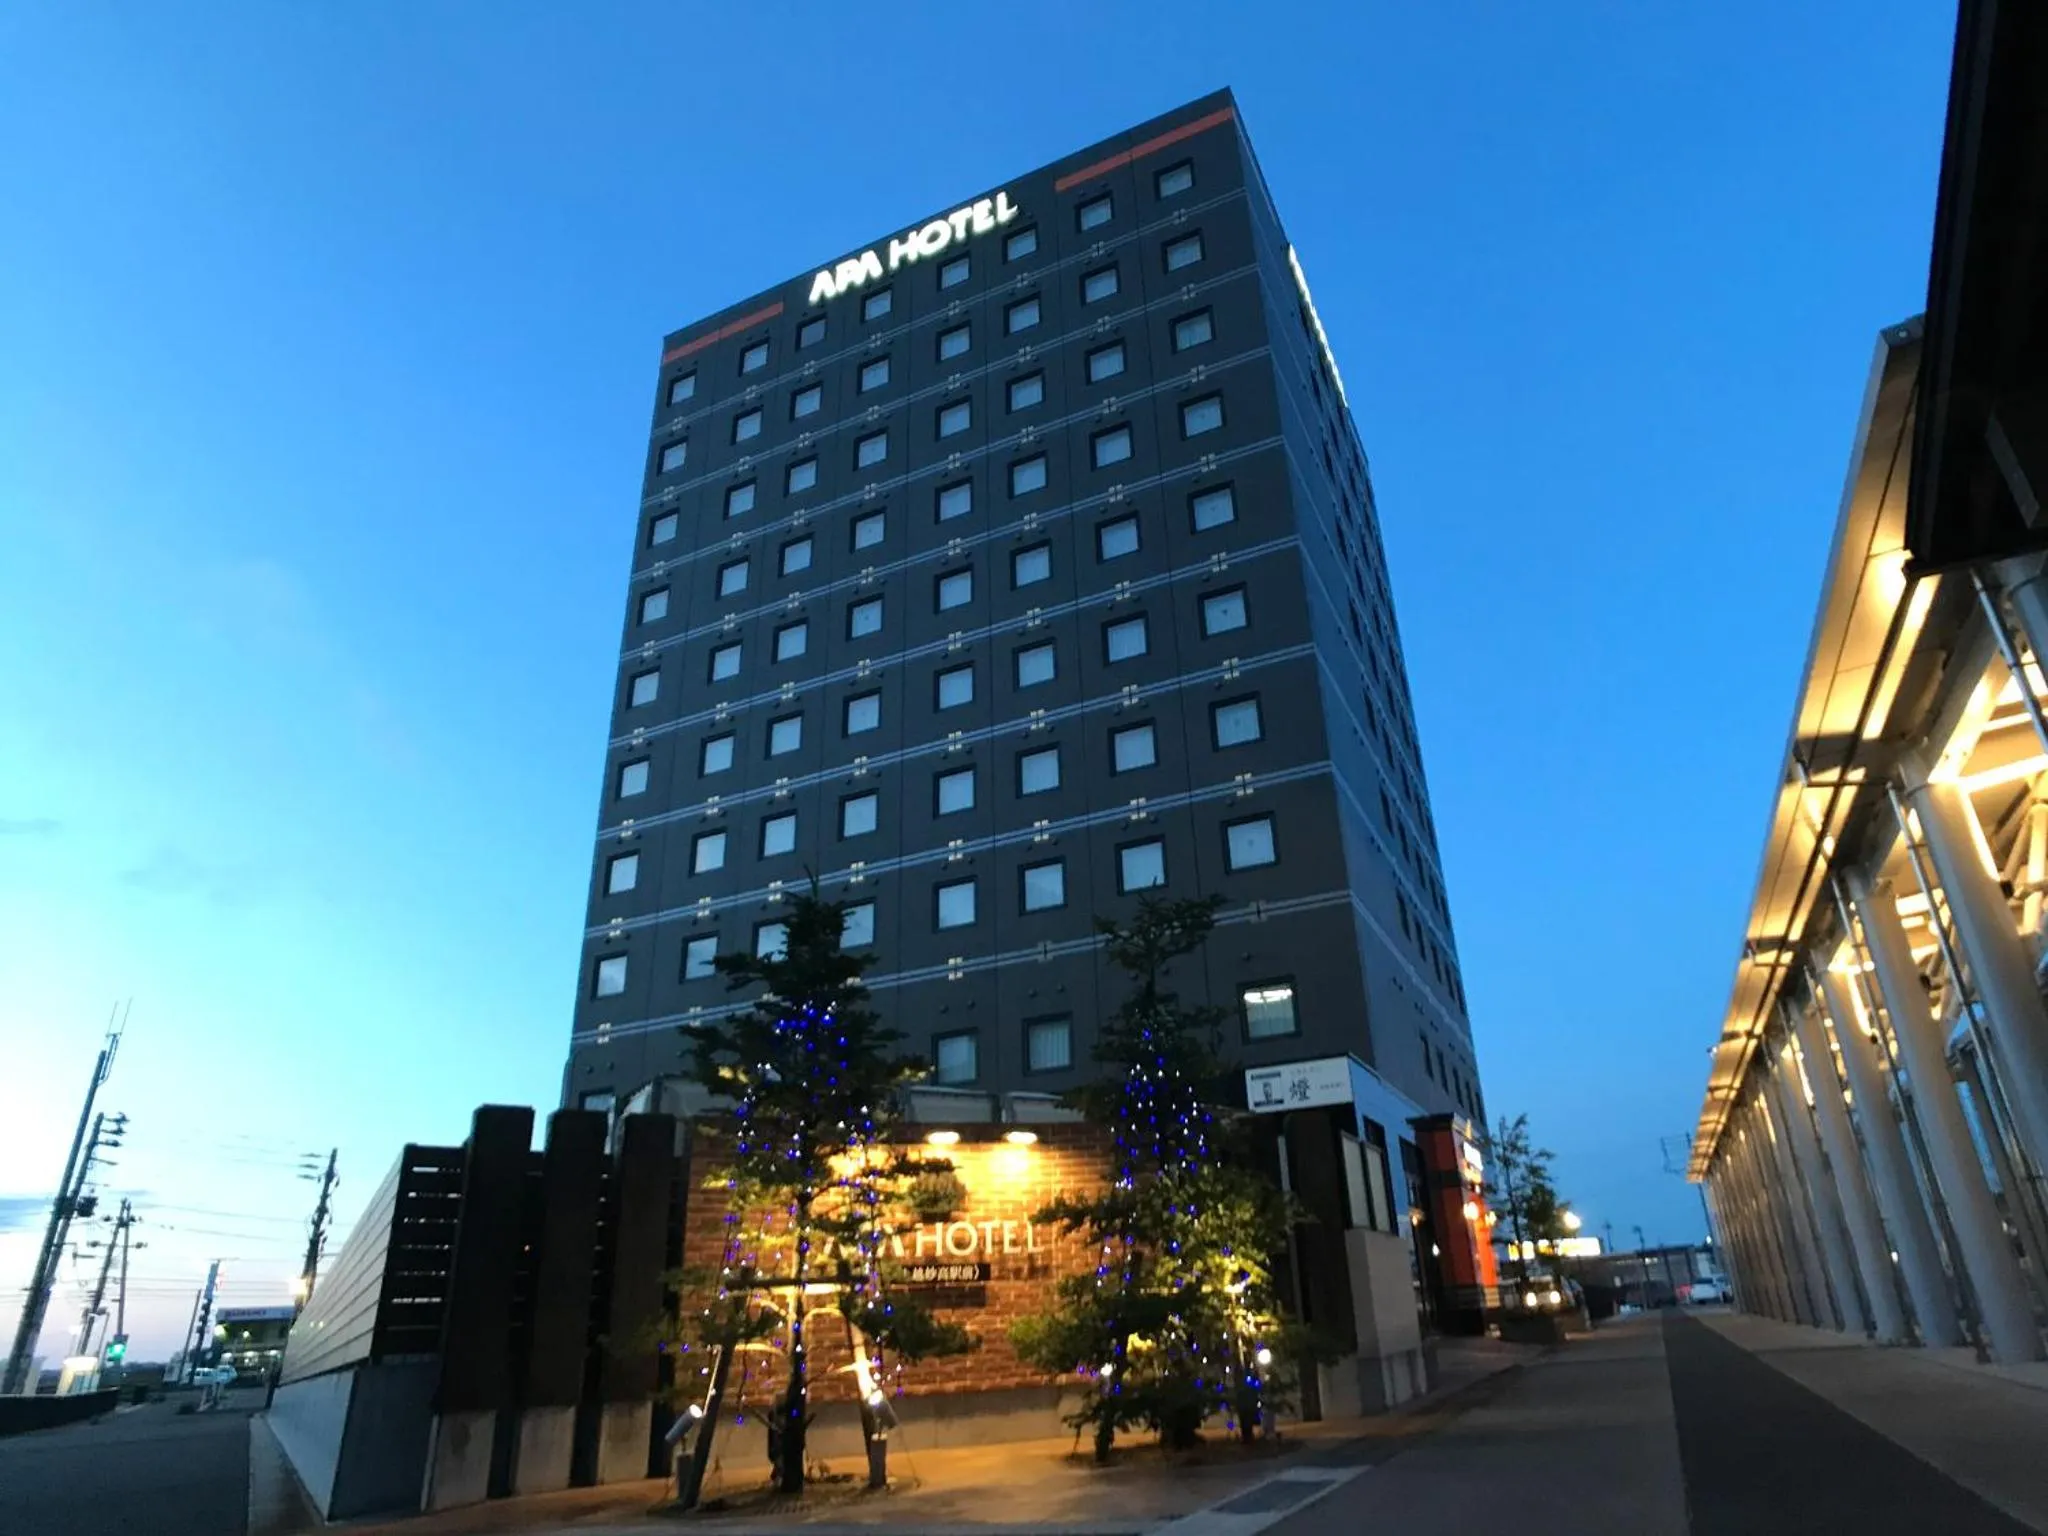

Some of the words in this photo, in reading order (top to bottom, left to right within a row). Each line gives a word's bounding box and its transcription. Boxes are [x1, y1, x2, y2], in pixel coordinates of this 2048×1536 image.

[808, 249, 883, 306] APA
[889, 191, 1018, 271] HOTEL
[914, 1220, 1045, 1257] HOTEL
